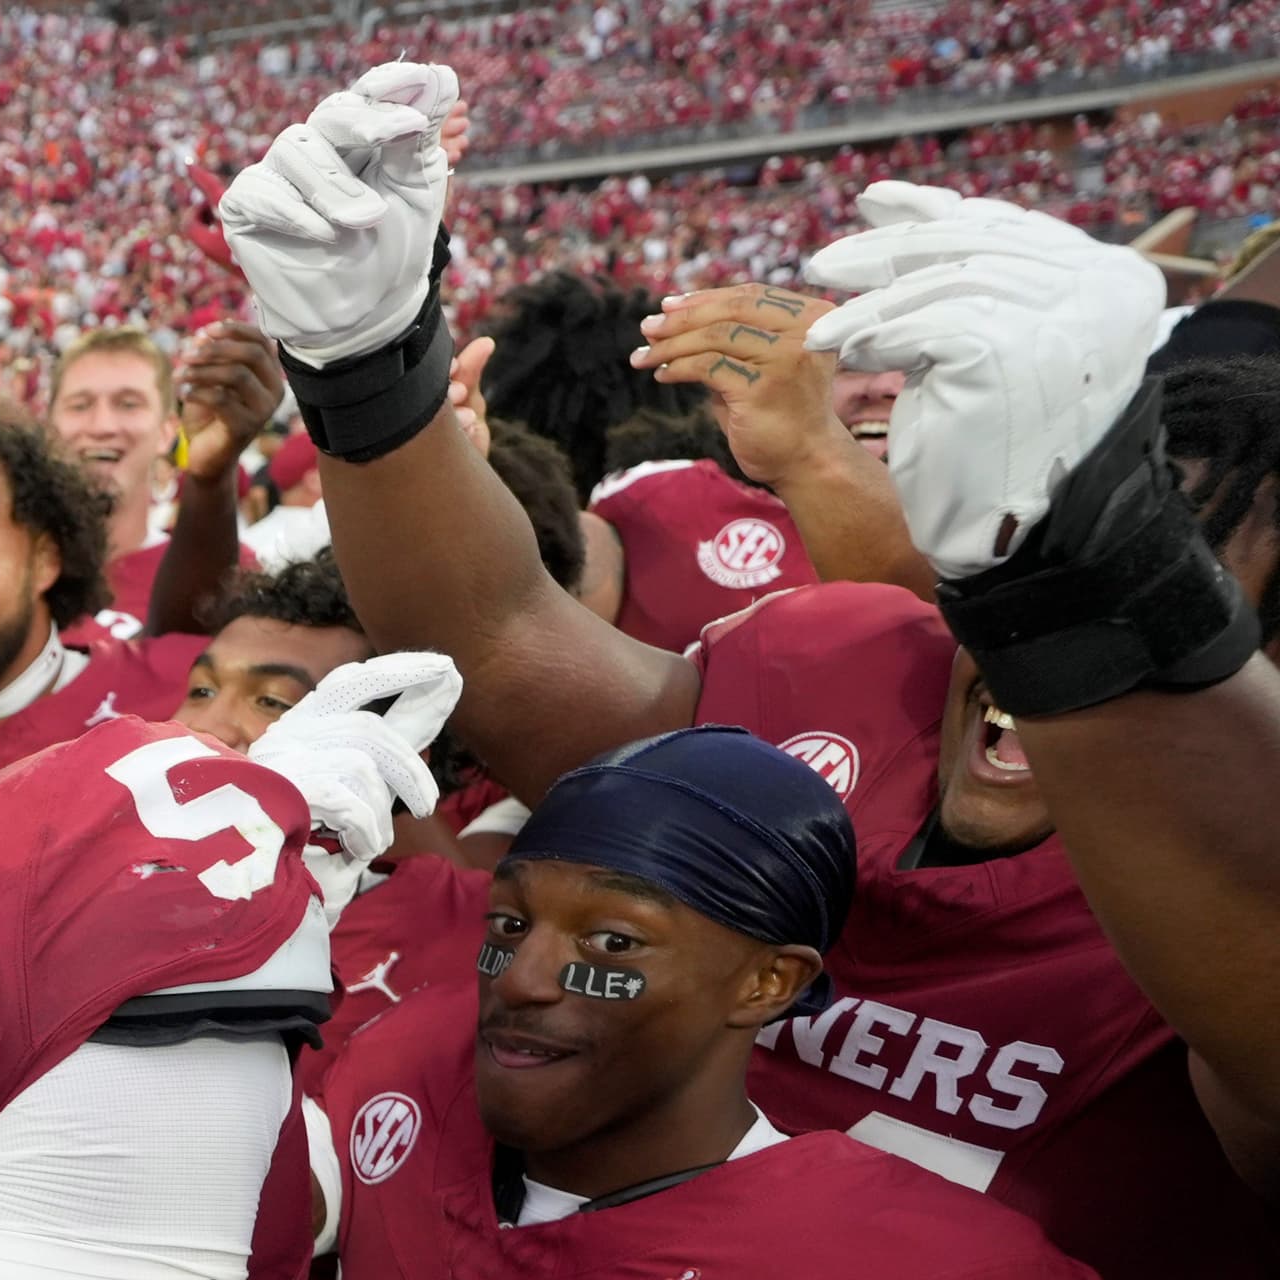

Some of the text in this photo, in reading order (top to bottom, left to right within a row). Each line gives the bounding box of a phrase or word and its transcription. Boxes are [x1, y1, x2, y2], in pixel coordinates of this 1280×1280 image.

[718, 521, 780, 571] SEC
[104, 735, 286, 902] 5
[354, 1098, 415, 1178] SEC
